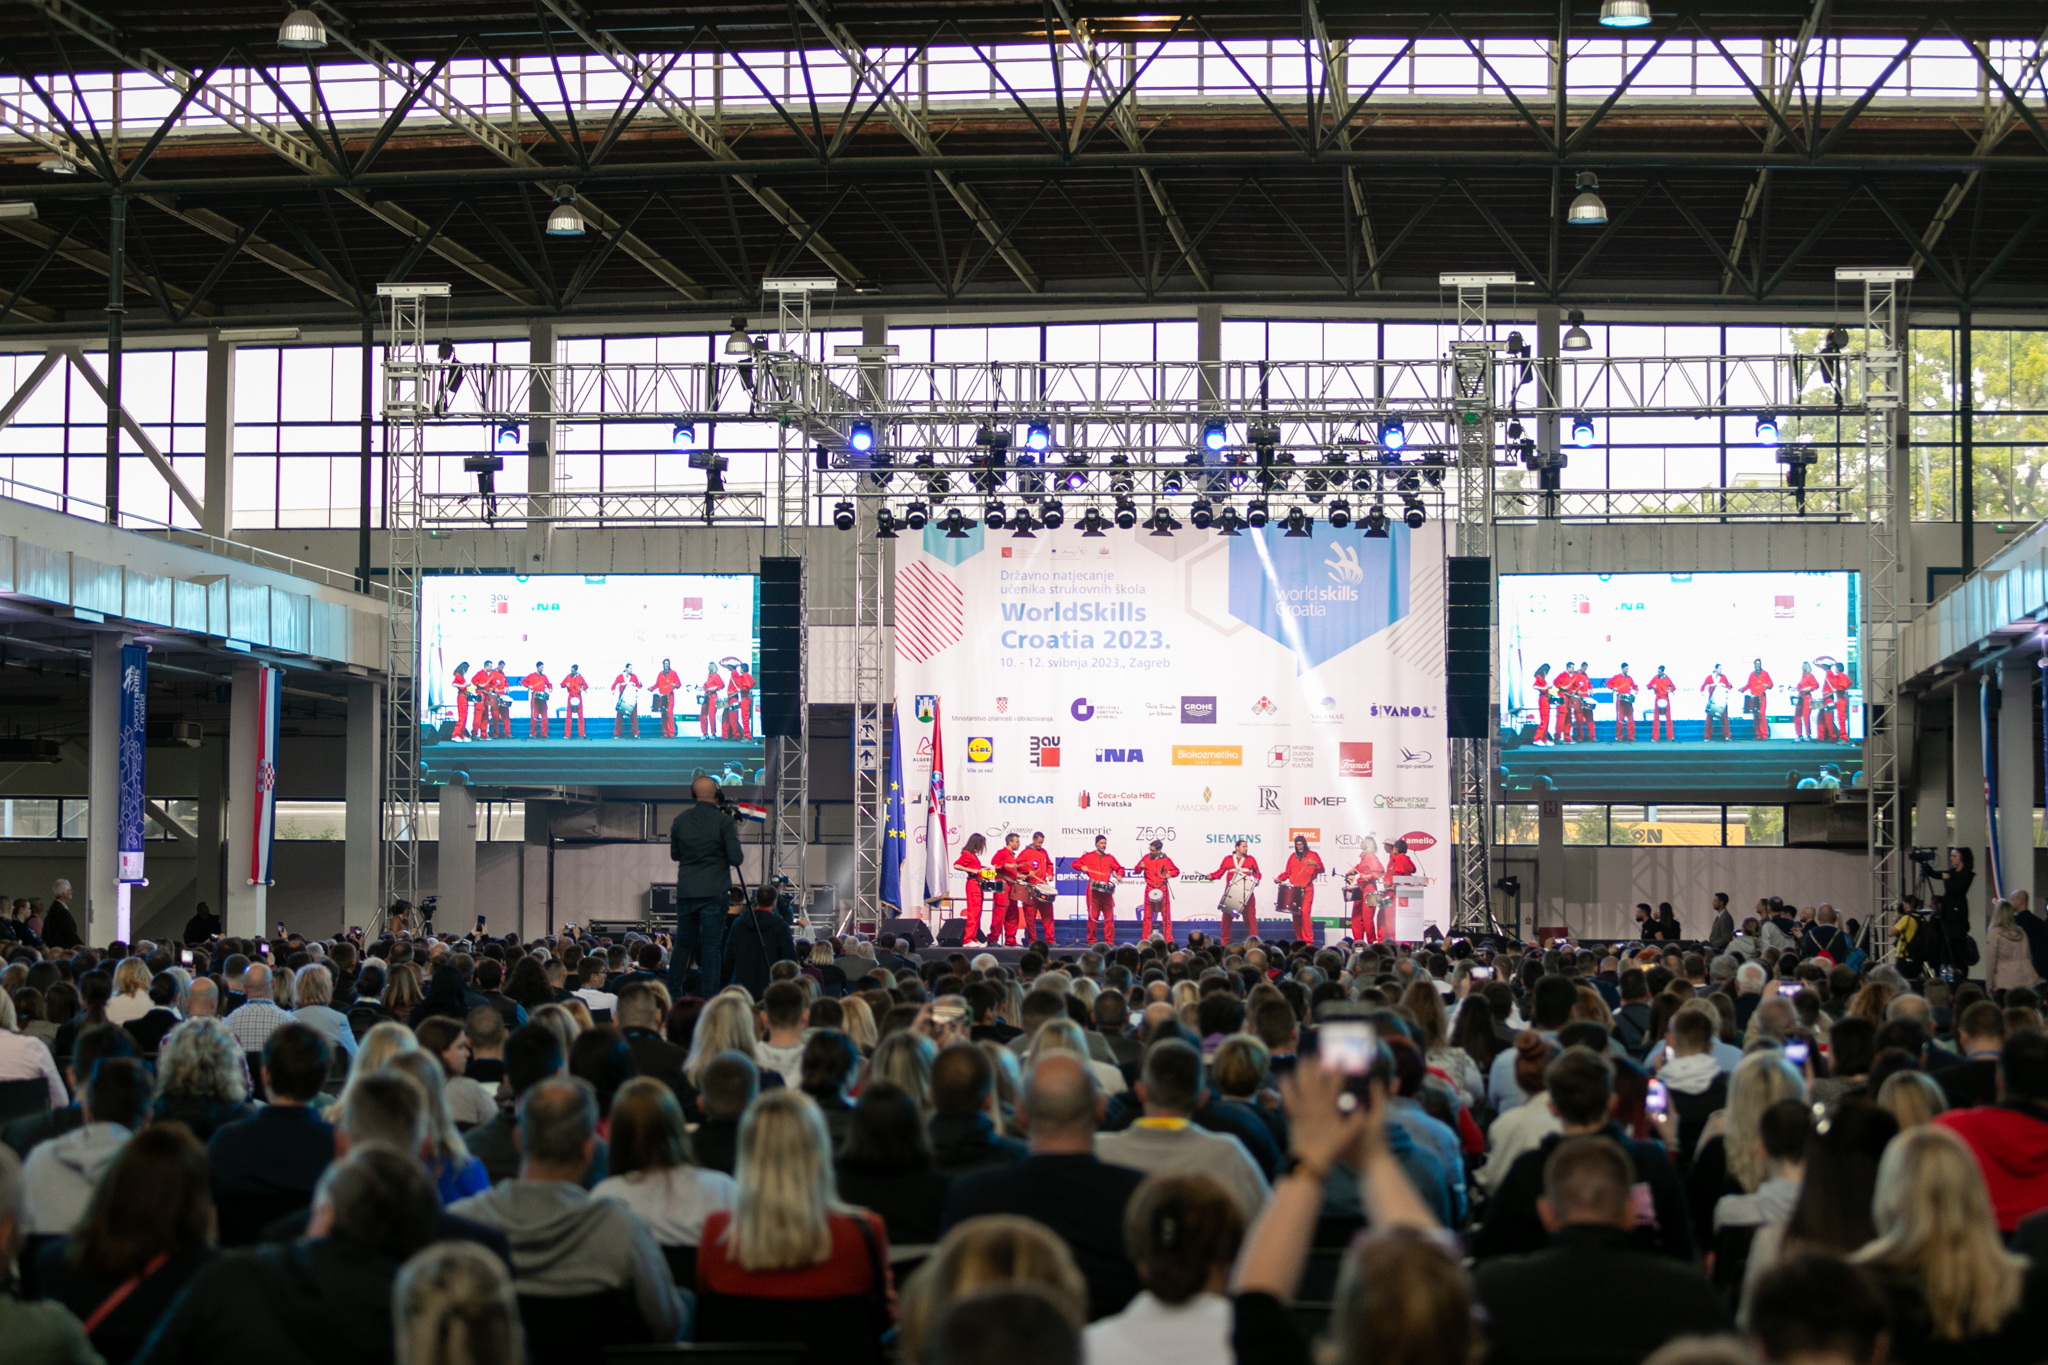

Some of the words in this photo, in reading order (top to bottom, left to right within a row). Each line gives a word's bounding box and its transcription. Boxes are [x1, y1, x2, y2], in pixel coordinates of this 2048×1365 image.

[1000, 570, 1050, 581] Državno
[1052, 570, 1115, 583] natjecanje
[1000, 584, 1046, 595] učenika
[1049, 584, 1112, 595] strukovnih
[1115, 583, 1146, 595] škola
[1001, 601, 1147, 622] WorldSkills
[1275, 601, 1326, 617] Croatia
[1001, 629, 1095, 650] Croatia
[1103, 629, 1171, 650] 2023.
[1000, 657, 1016, 668] 10.
[1028, 657, 1045, 668] 12.
[1048, 657, 1088, 670] svibnja
[1129, 657, 1171, 670] Zagreb
[1184, 703, 1213, 711] GROHE
[1016, 715, 1053, 723] obrazovanja
[1177, 749, 1239, 759] Biokozmetika
[998, 793, 1054, 804] KONČAR
[1097, 792, 1138, 800] Coca-Cola
[1139, 792, 1156, 800] HBC
[1175, 804, 1215, 812] AMADRIA
[1217, 804, 1240, 812] PARK
[1061, 825, 1112, 835] mesmerie
[1292, 831, 1318, 839] STIHL
[1206, 833, 1262, 844] SIEMENS
